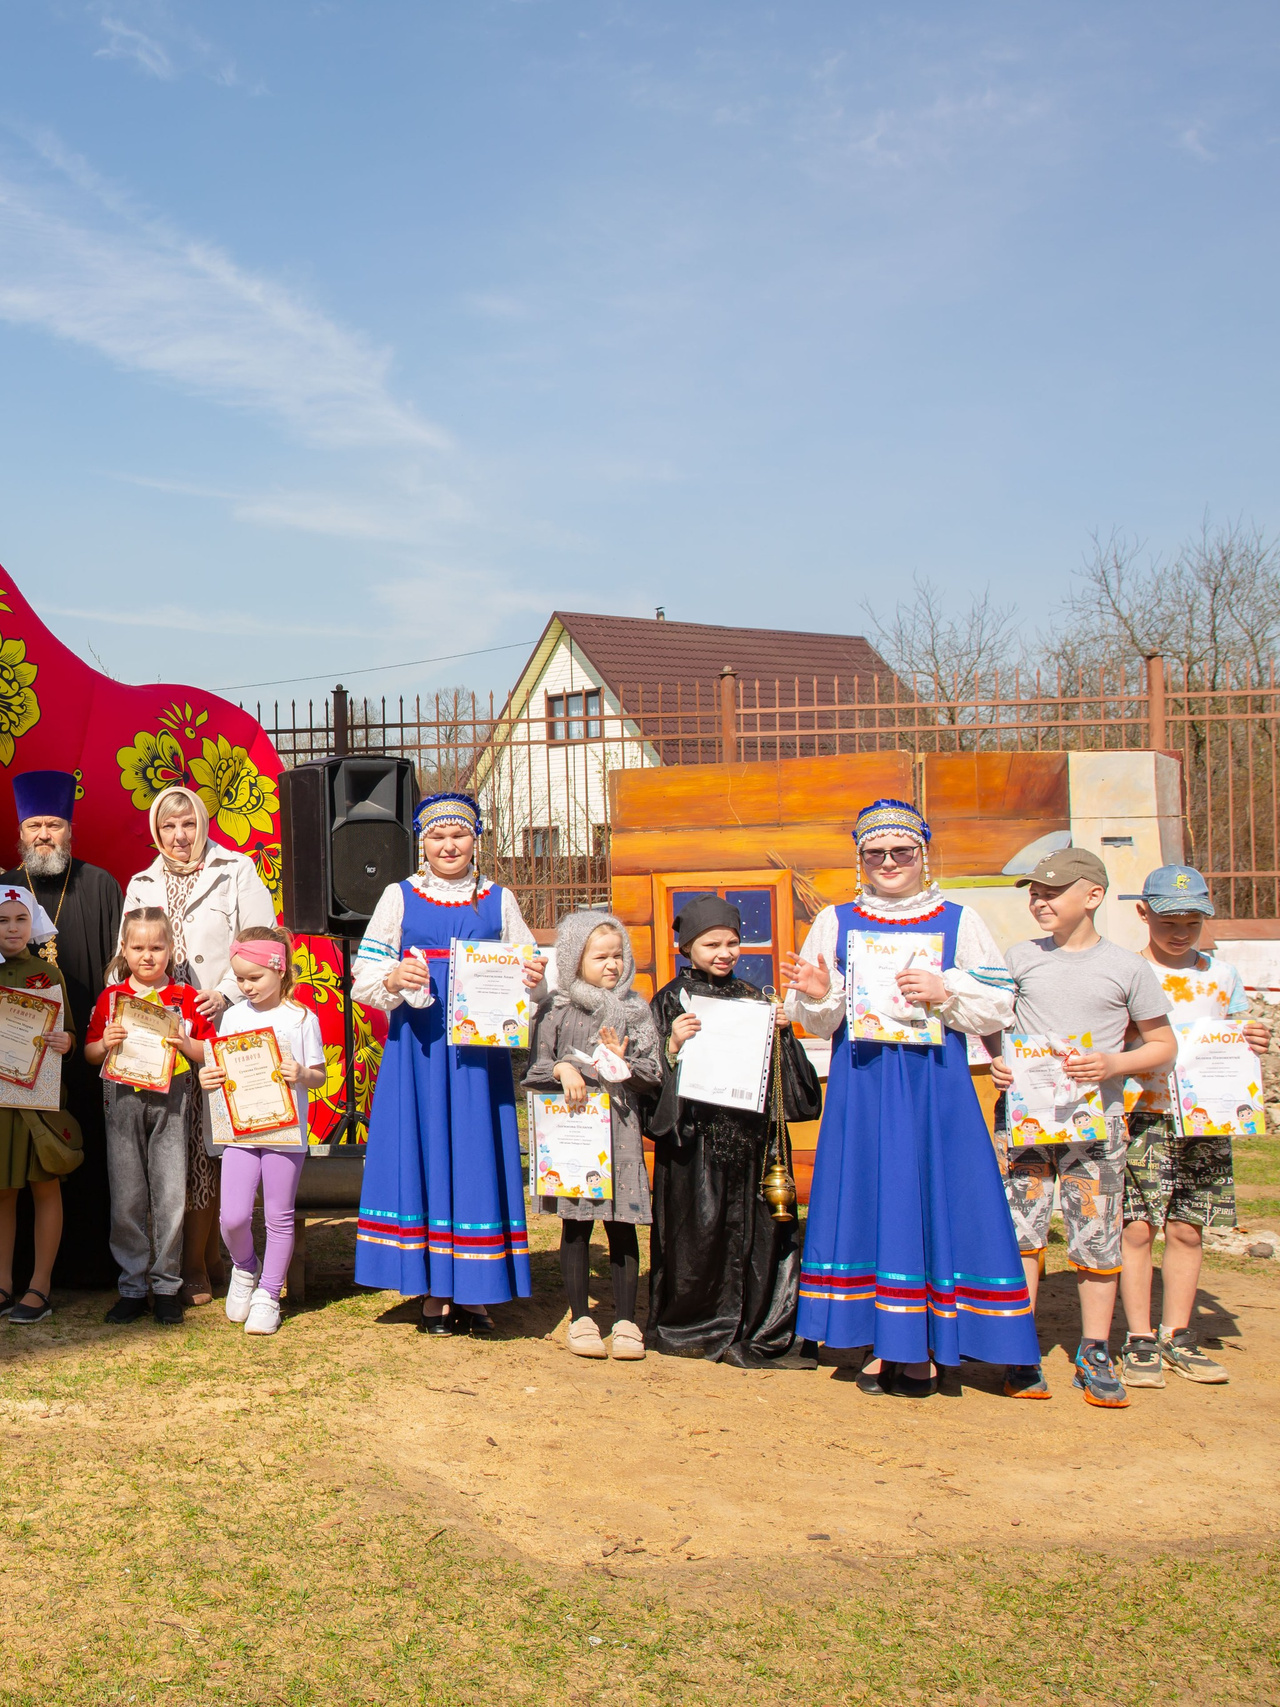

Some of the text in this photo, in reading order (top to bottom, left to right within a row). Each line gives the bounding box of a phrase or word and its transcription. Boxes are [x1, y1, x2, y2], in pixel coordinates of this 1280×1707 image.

[466, 953, 521, 966] ГРАМОТА
[9, 1007, 36, 1020] ГРАМОТА
[234, 1053, 261, 1064] ГРАМОТА
[545, 1104, 599, 1115] ГРАМОТА
